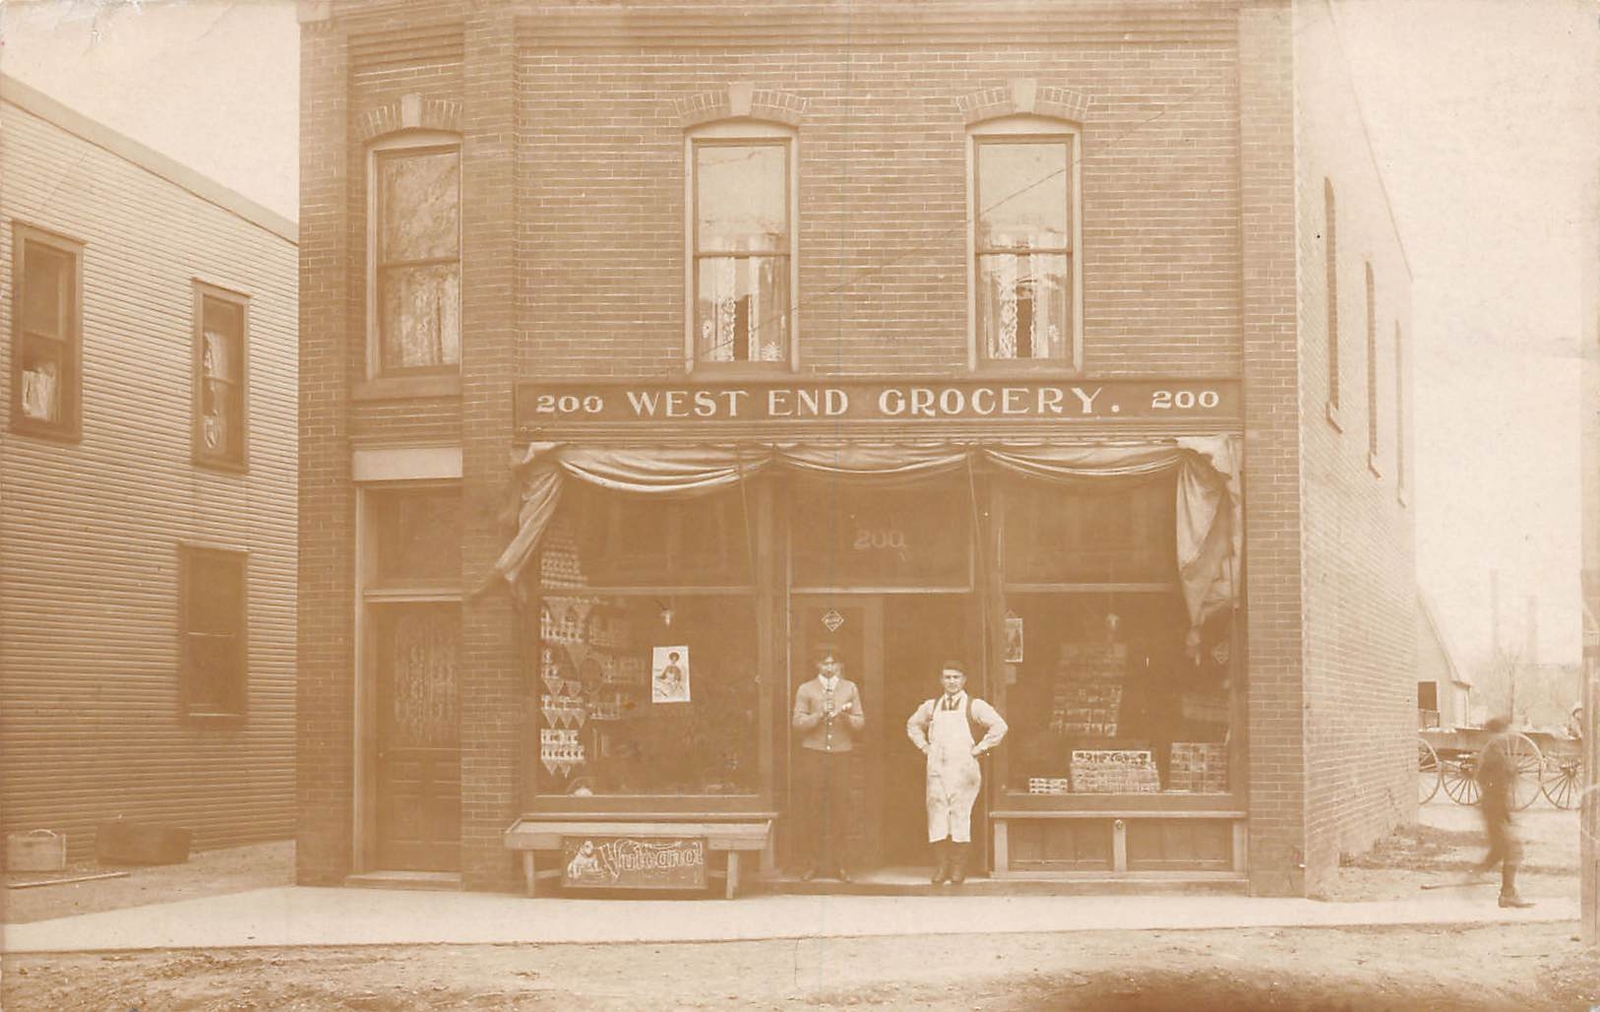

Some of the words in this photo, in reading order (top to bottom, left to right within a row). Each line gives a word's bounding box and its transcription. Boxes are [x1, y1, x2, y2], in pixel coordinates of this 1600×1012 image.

[535, 395, 604, 414] 200
[626, 390, 749, 418] WEST
[768, 389, 849, 416] END
[878, 387, 1120, 417] GROCERY.
[1151, 390, 1219, 410] 200
[853, 528, 905, 551] 200
